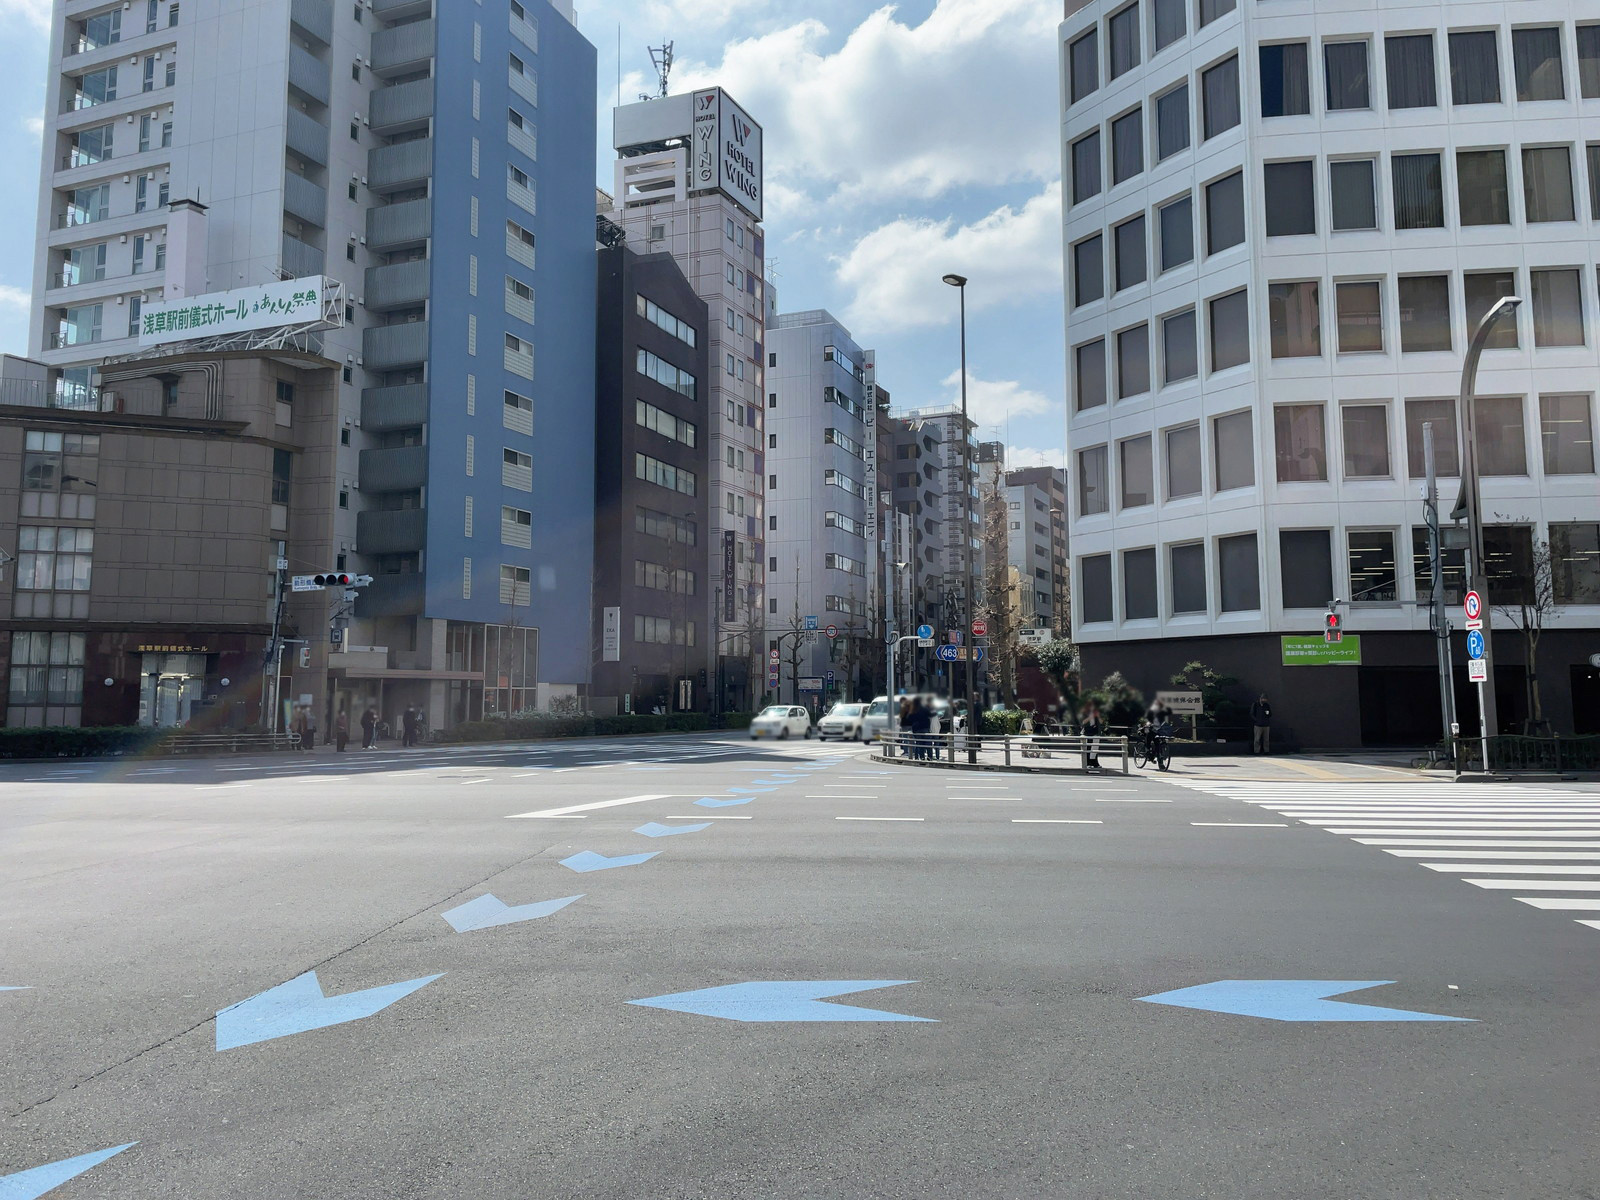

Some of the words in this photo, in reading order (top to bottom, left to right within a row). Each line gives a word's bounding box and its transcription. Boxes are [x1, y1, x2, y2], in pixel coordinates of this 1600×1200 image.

[696, 114, 716, 123] HOTEL
[697, 124, 714, 182] WING
[727, 140, 756, 178] HOTEL
[725, 159, 758, 201] WING
[142, 299, 248, 336] 浅草駅前儀式ホール
[260, 289, 317, 315] あんしん祭典
[943, 649, 957, 658] 463
[1470, 637, 1477, 655] P
[827, 672, 834, 680] P
